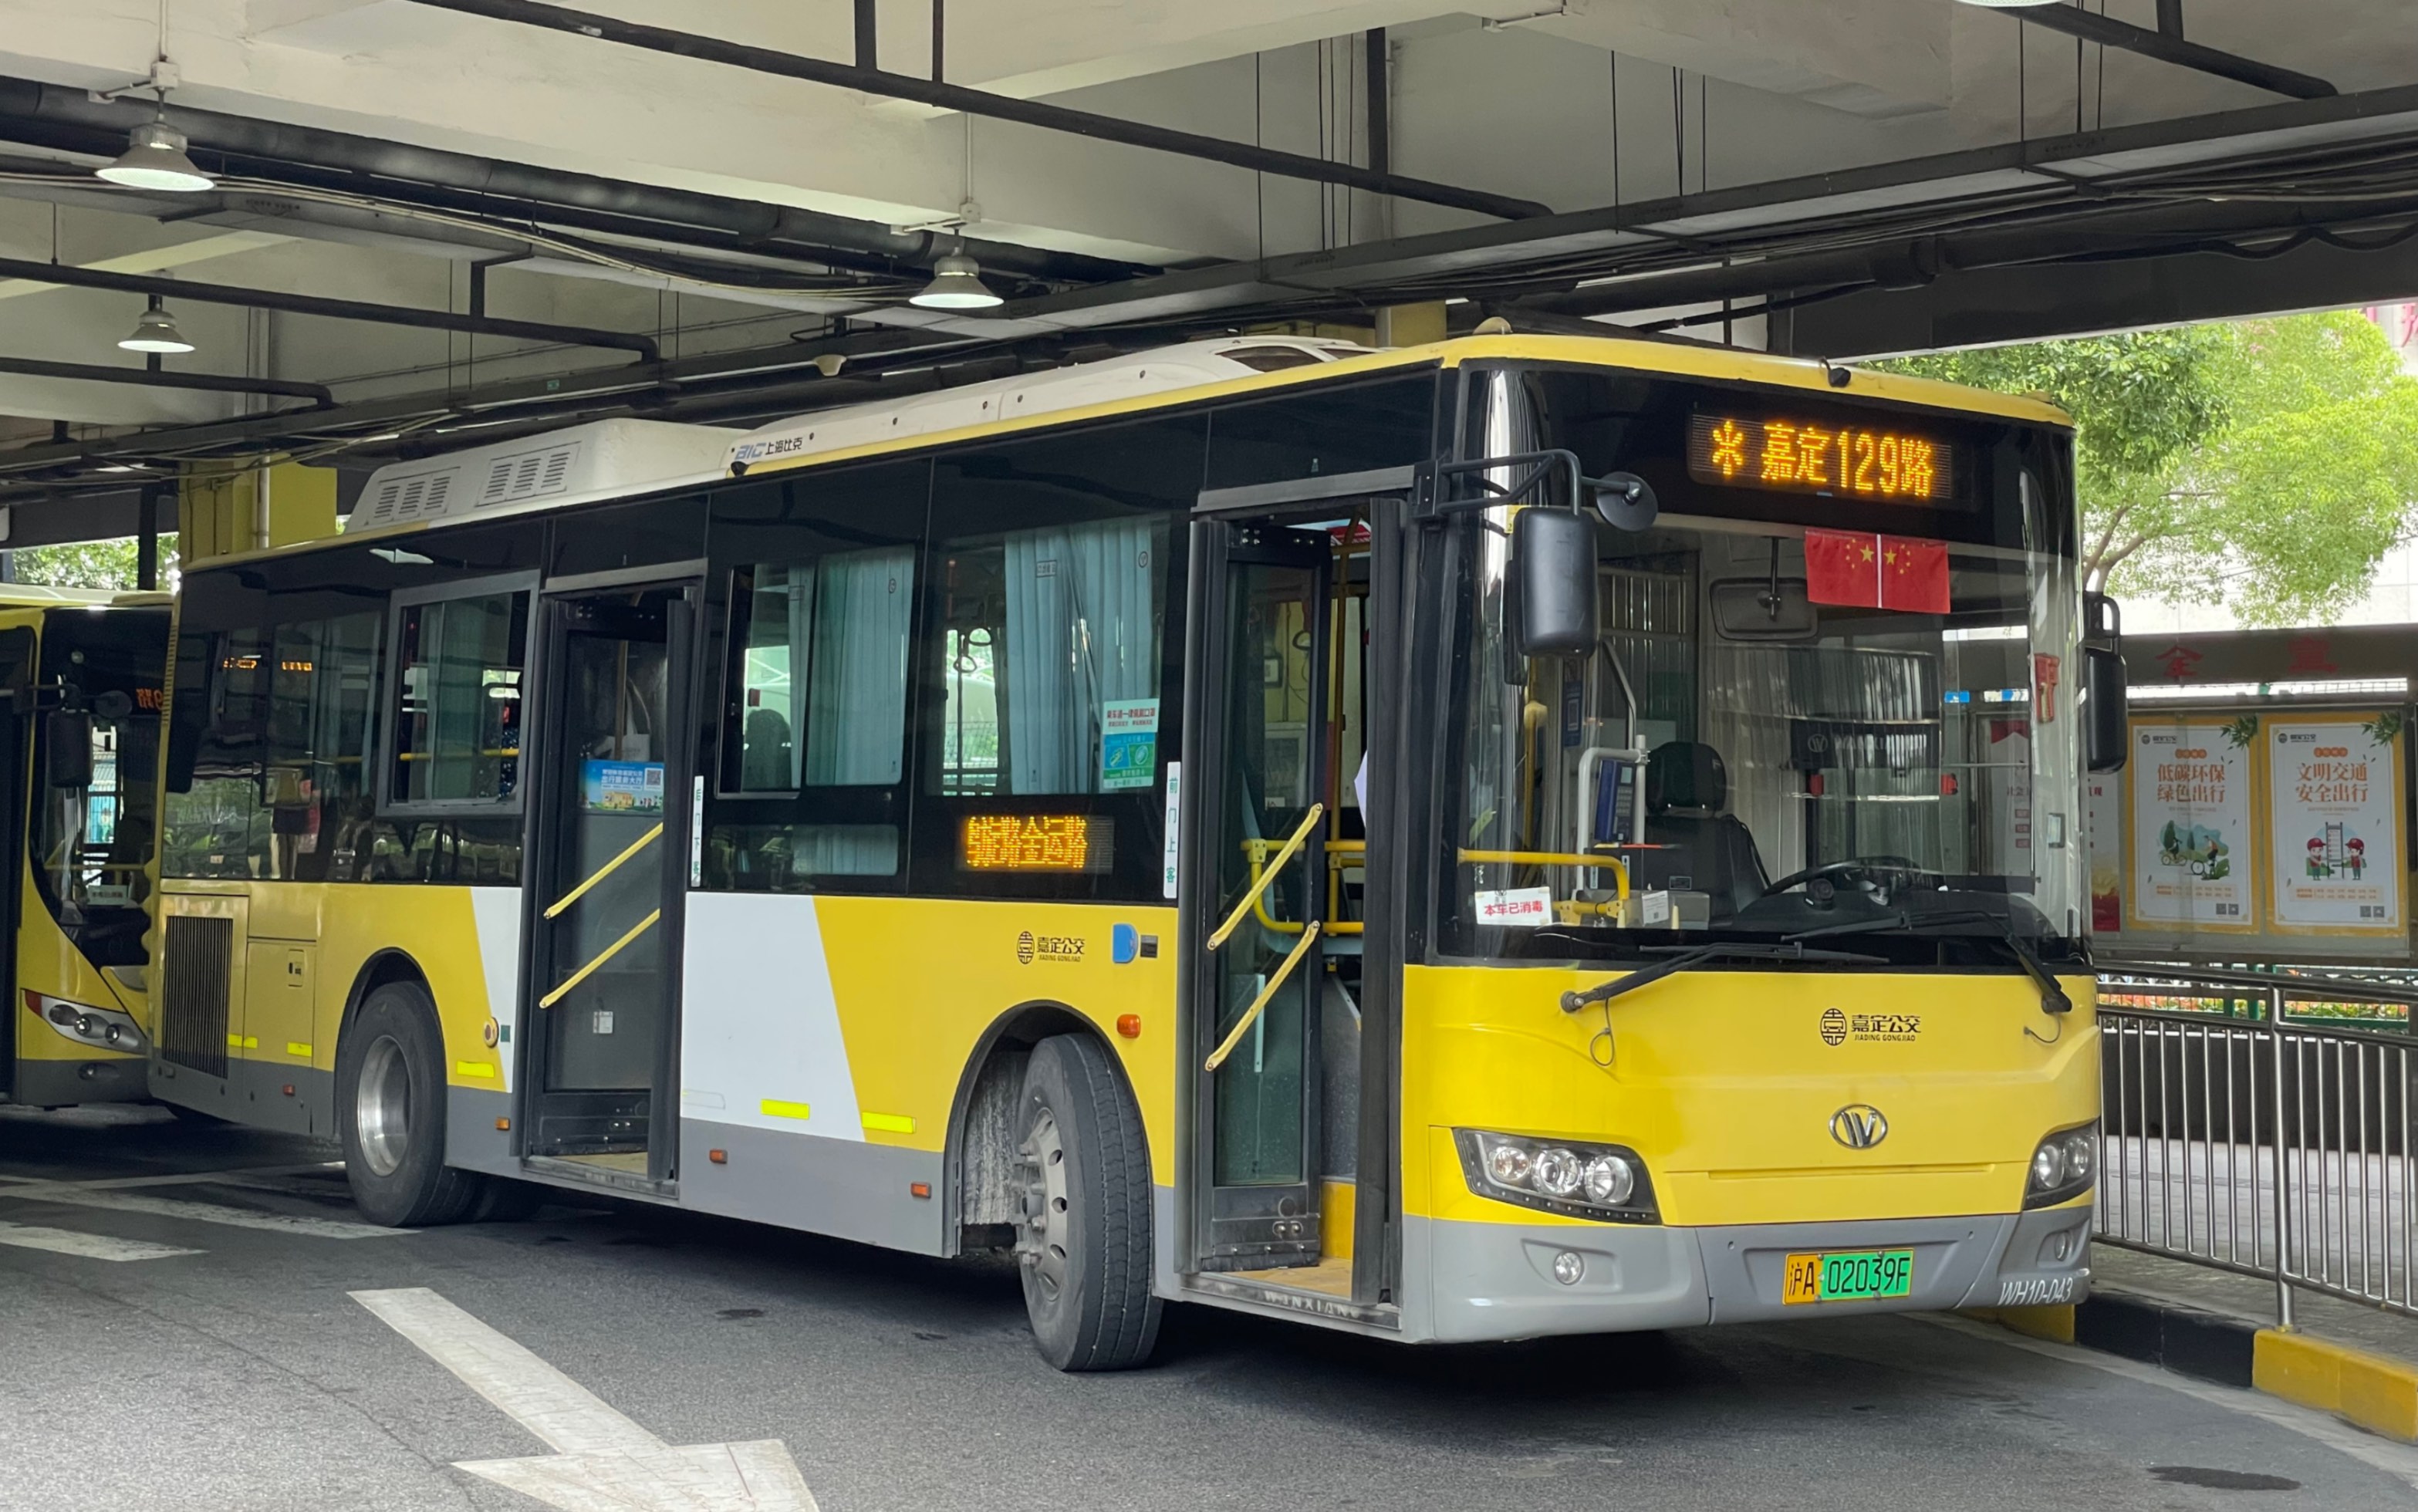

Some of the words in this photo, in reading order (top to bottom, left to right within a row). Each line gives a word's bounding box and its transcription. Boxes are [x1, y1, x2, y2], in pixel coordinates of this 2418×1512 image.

[765, 437, 802, 455] 上海比克
[1761, 424, 1933, 496] 嘉定129路
[2157, 764, 2225, 782] 低碳环保
[2296, 762, 2368, 781] 文明交通
[2157, 784, 2225, 802] 绿色出行
[2295, 784, 2369, 802] 安全出行
[1166, 778, 1178, 883] 前门上客
[1484, 901, 1544, 916] 本车已消毒
[1037, 937, 1086, 955] 嘉定公交
[1851, 1014, 1921, 1033] 嘉定公交
[1997, 1277, 2074, 1306] WH10-043
